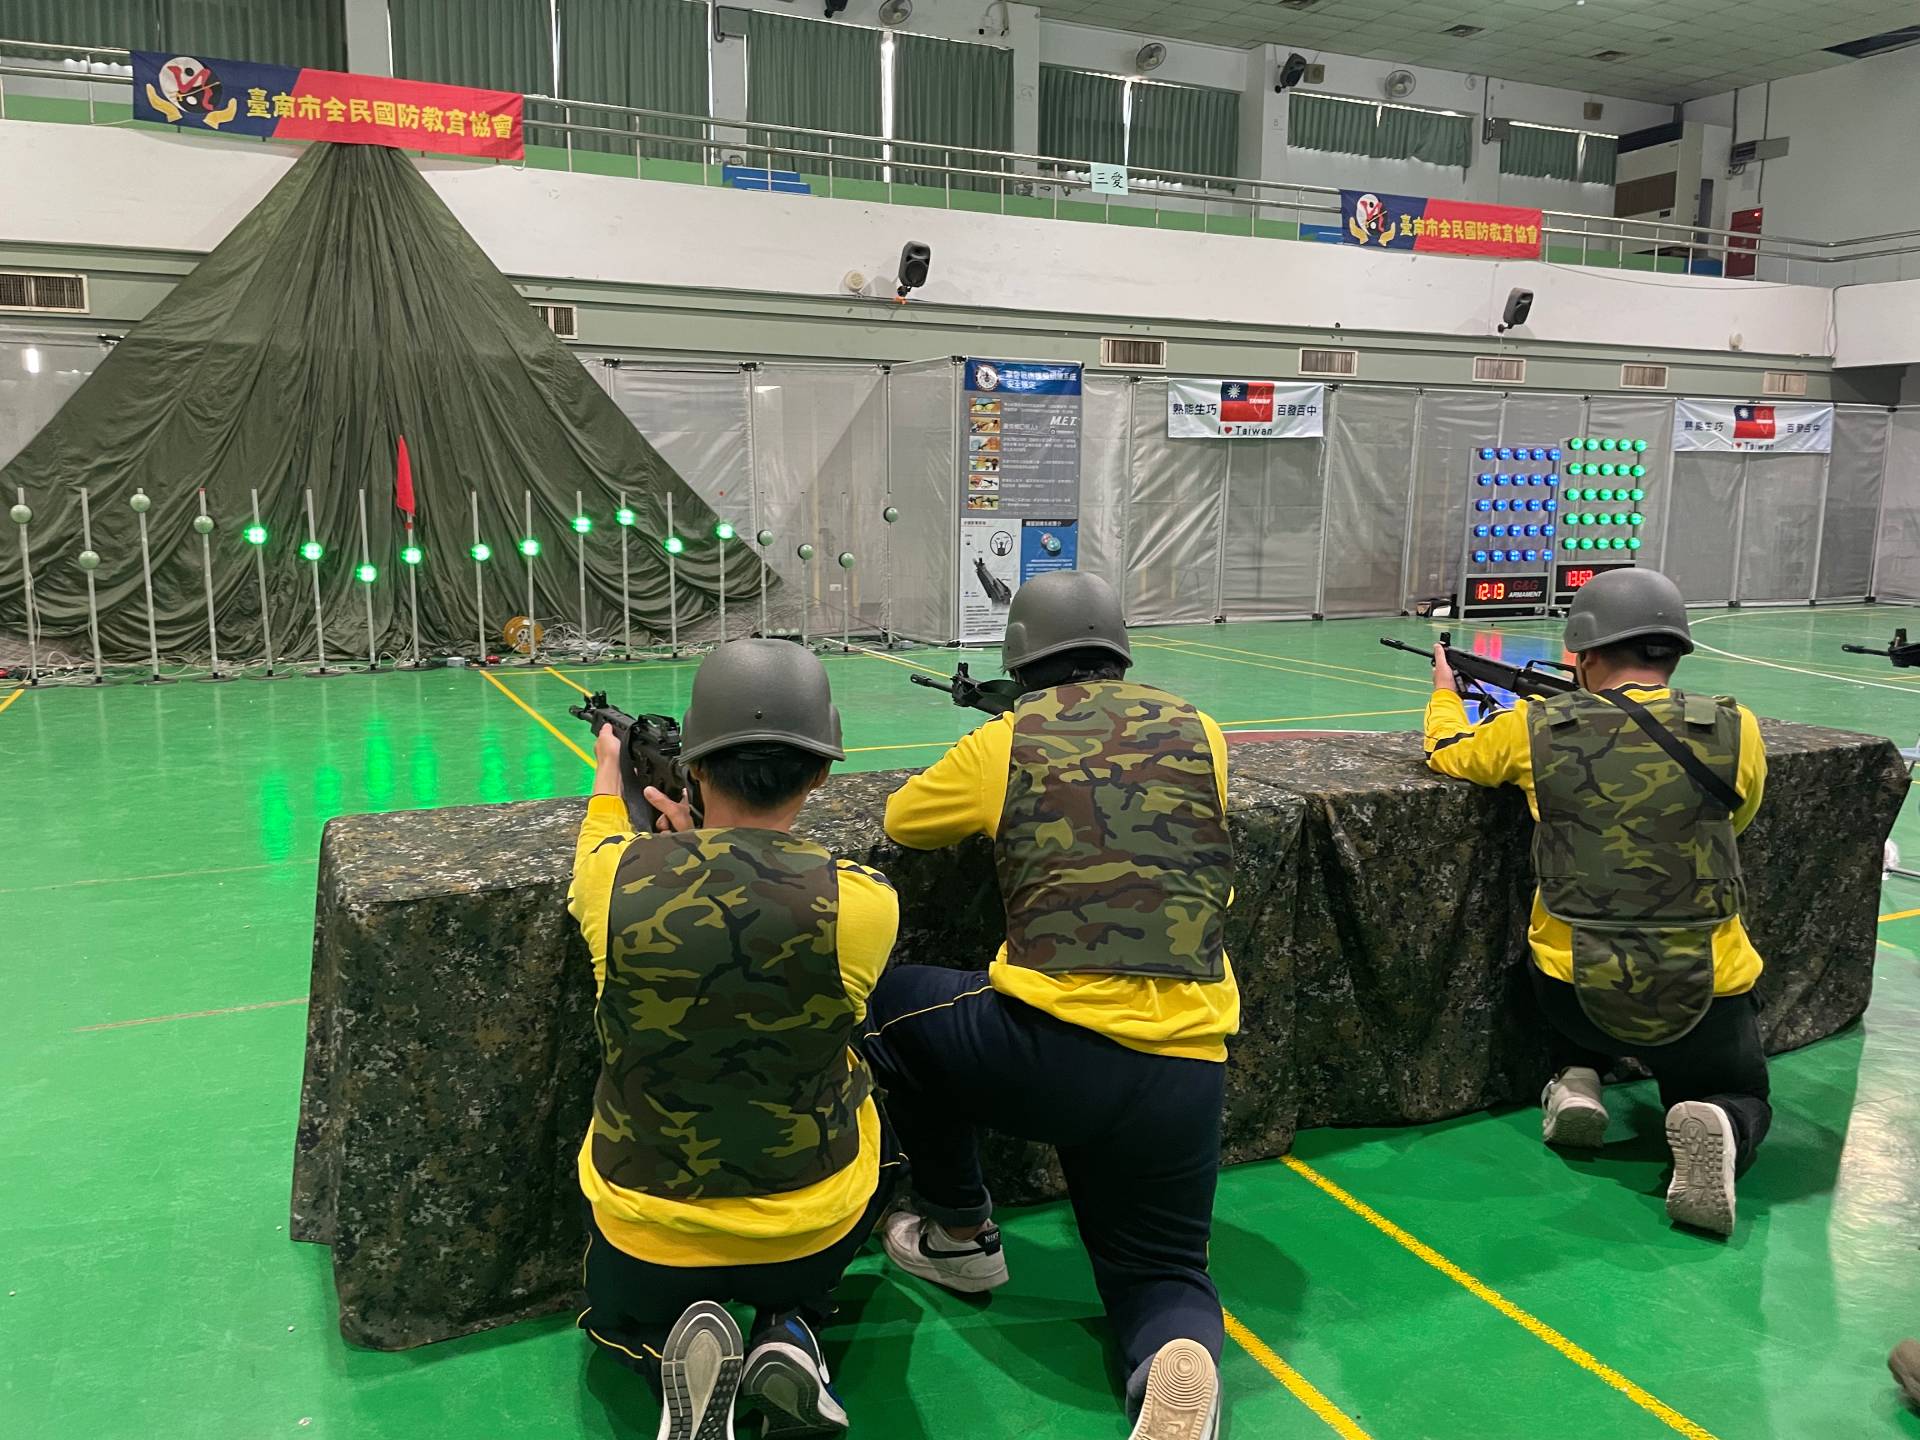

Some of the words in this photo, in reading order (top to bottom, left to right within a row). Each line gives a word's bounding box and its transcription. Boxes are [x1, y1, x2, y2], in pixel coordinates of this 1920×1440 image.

[246, 87, 513, 139] 臺南市全民國防教育協會
[1094, 171, 1124, 189] 三愛
[1401, 213, 1537, 244] 臺南市全民國防教育協會
[1172, 403, 1217, 416] 熟能生巧
[1277, 404, 1317, 417] 百發百中
[1236, 425, 1273, 436] Taiwan
